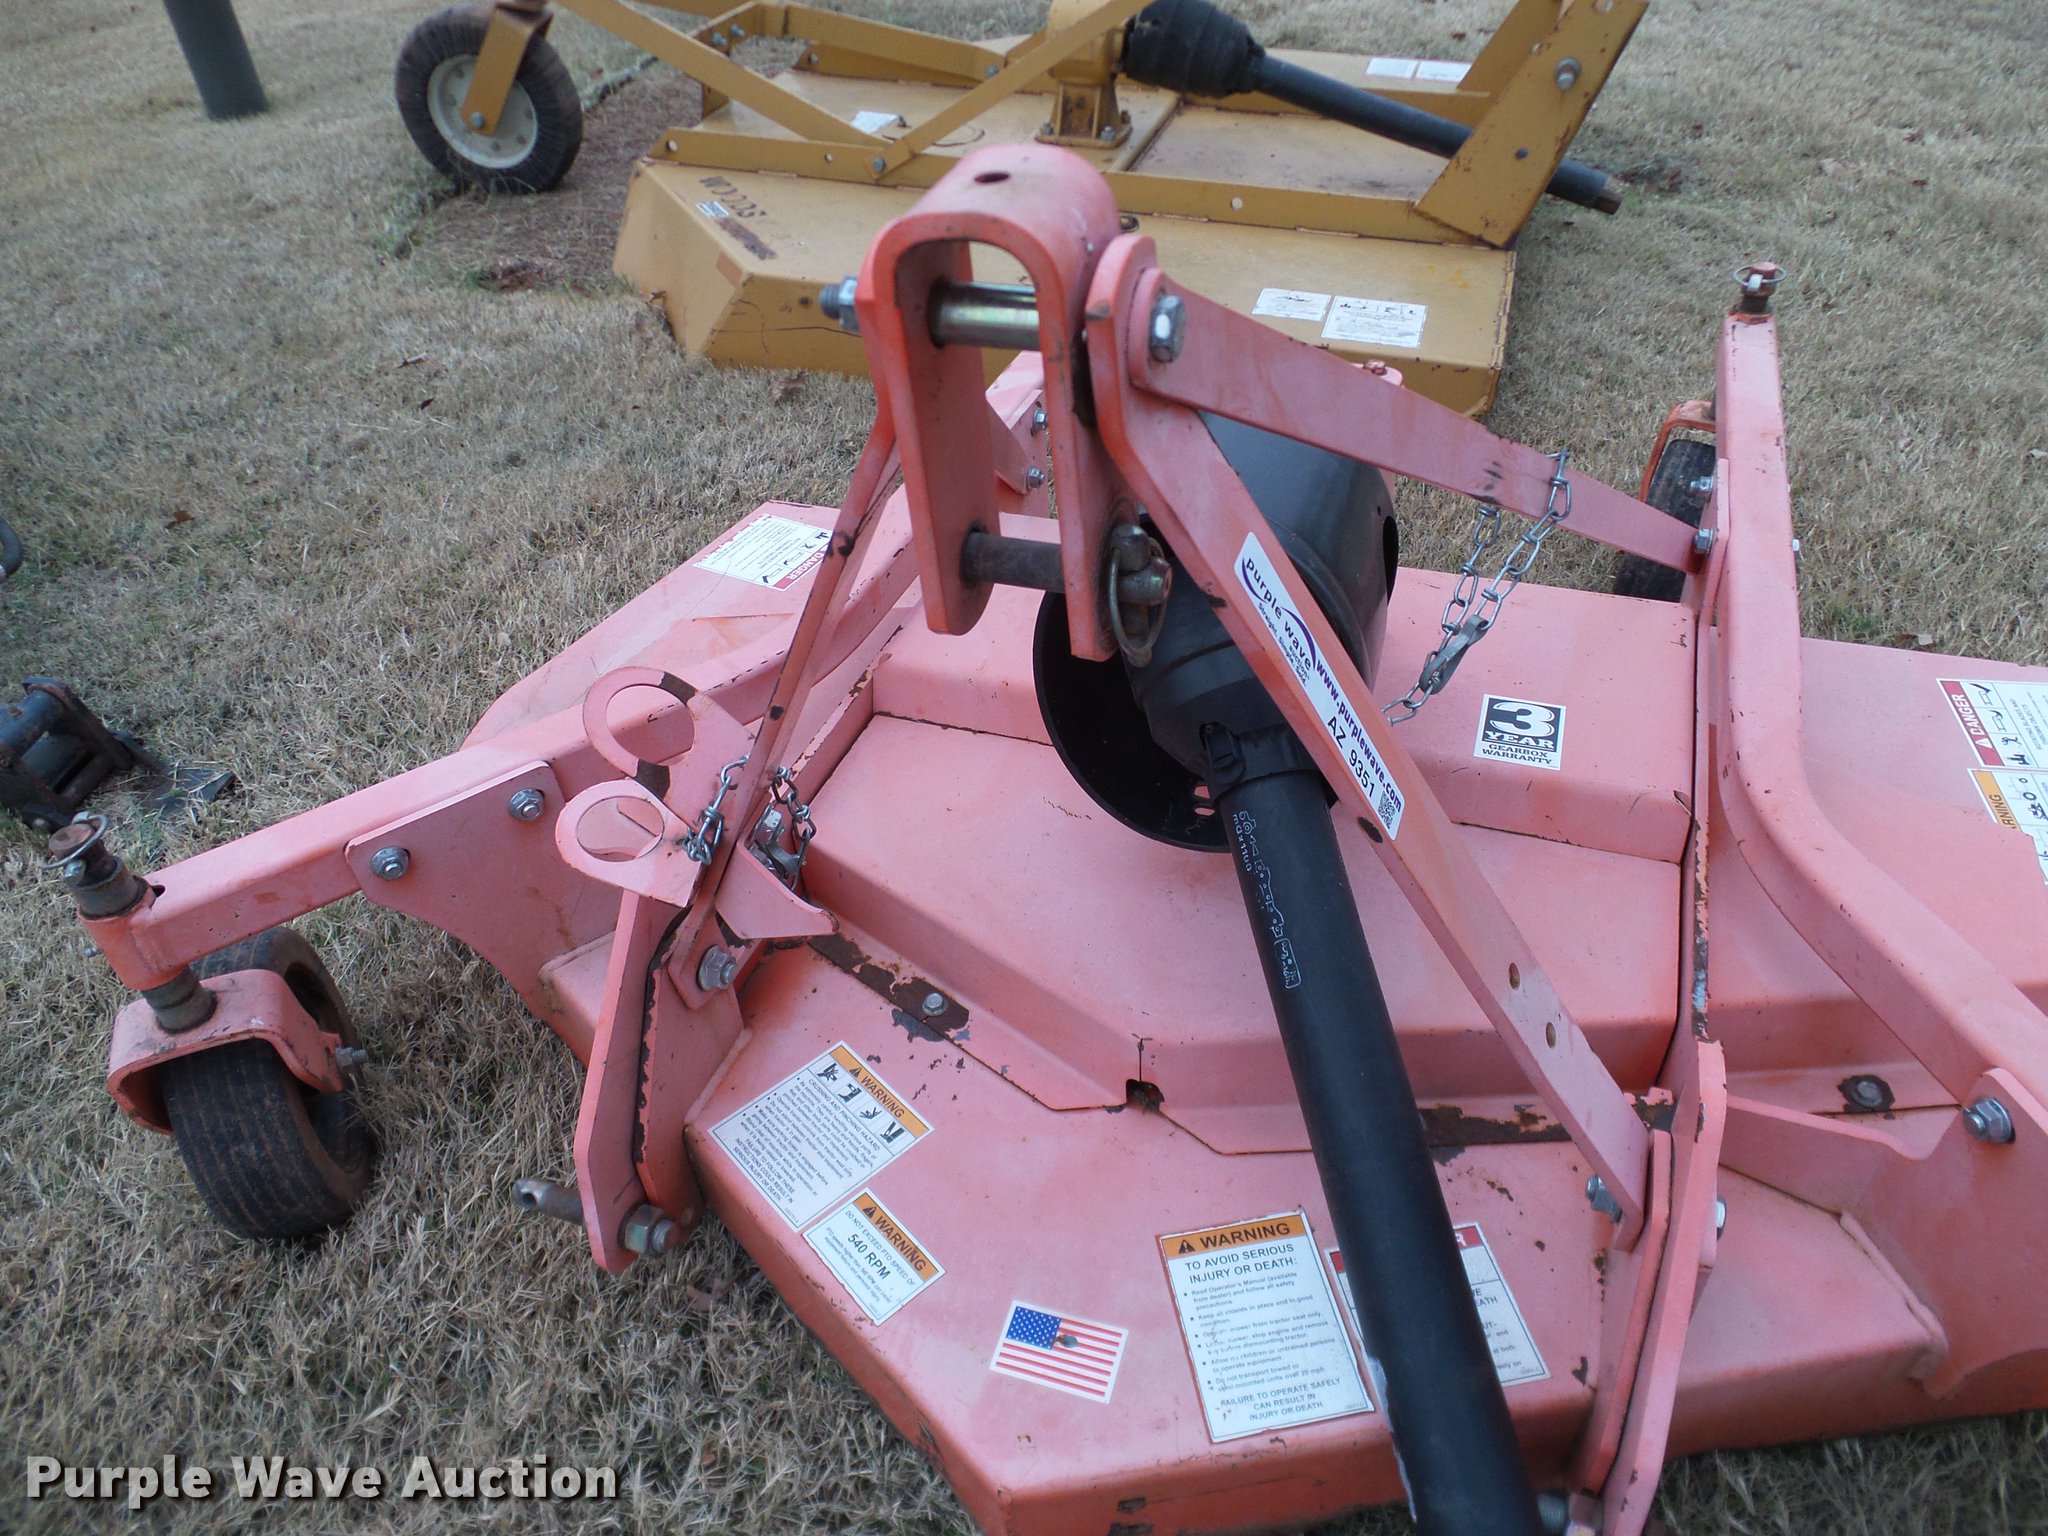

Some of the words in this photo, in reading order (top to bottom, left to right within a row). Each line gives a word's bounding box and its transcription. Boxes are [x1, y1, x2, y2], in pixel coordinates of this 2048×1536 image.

[1245, 557, 1282, 620] purple
[1283, 620, 1311, 671] wave
[1490, 702, 1555, 737] 3
[1952, 694, 1984, 736] DANGER
[1315, 658, 1401, 813] www.purplewave.com
[1485, 731, 1554, 749] YEAR
[1489, 744, 1548, 758] GEARBOX
[1327, 711, 1346, 749] AZ
[1348, 746, 1374, 798] 9351
[1482, 749, 1552, 764] WARRANTY
[1989, 794, 2016, 829] RNING
[859, 1075, 906, 1118] WARNING
[807, 1078, 832, 1102] CRUSHING
[828, 1100, 841, 1111] AND
[838, 1109, 862, 1132] PINCHING
[858, 1130, 881, 1151] HAZARD
[744, 1138, 762, 1156] FAILURE
[764, 1161, 783, 1180] FOLLOW
[780, 1178, 795, 1194] THESE
[844, 1209, 855, 1219] DO
[851, 1217, 864, 1229] NOT
[861, 1228, 883, 1250] EXCEED
[879, 1248, 892, 1262] PTO
[889, 1260, 908, 1280] SPEED
[905, 1277, 915, 1286] OF
[873, 1215, 927, 1272] WARNING
[1199, 1222, 1290, 1249] WARNING
[846, 1232, 869, 1254] 540
[863, 1251, 891, 1280] RPM
[1184, 1260, 1201, 1271] TO
[1202, 1253, 1240, 1268] AVOID
[1241, 1243, 1294, 1260] SERIOUS
[1188, 1267, 1232, 1284] INJURY
[1233, 1264, 1252, 1276] OR
[1253, 1256, 1298, 1272] DEATH:
[1242, 1276, 1266, 1286] Manual
[1252, 1401, 1271, 1410] CAN
[1272, 1394, 1306, 1406] RESULT
[1256, 1391, 1268, 1400] TO
[1269, 1383, 1309, 1397] OPERATE
[1309, 1377, 1341, 1389] SAFELY
[1248, 1409, 1279, 1421] INJURY
[1280, 1406, 1294, 1415] OR
